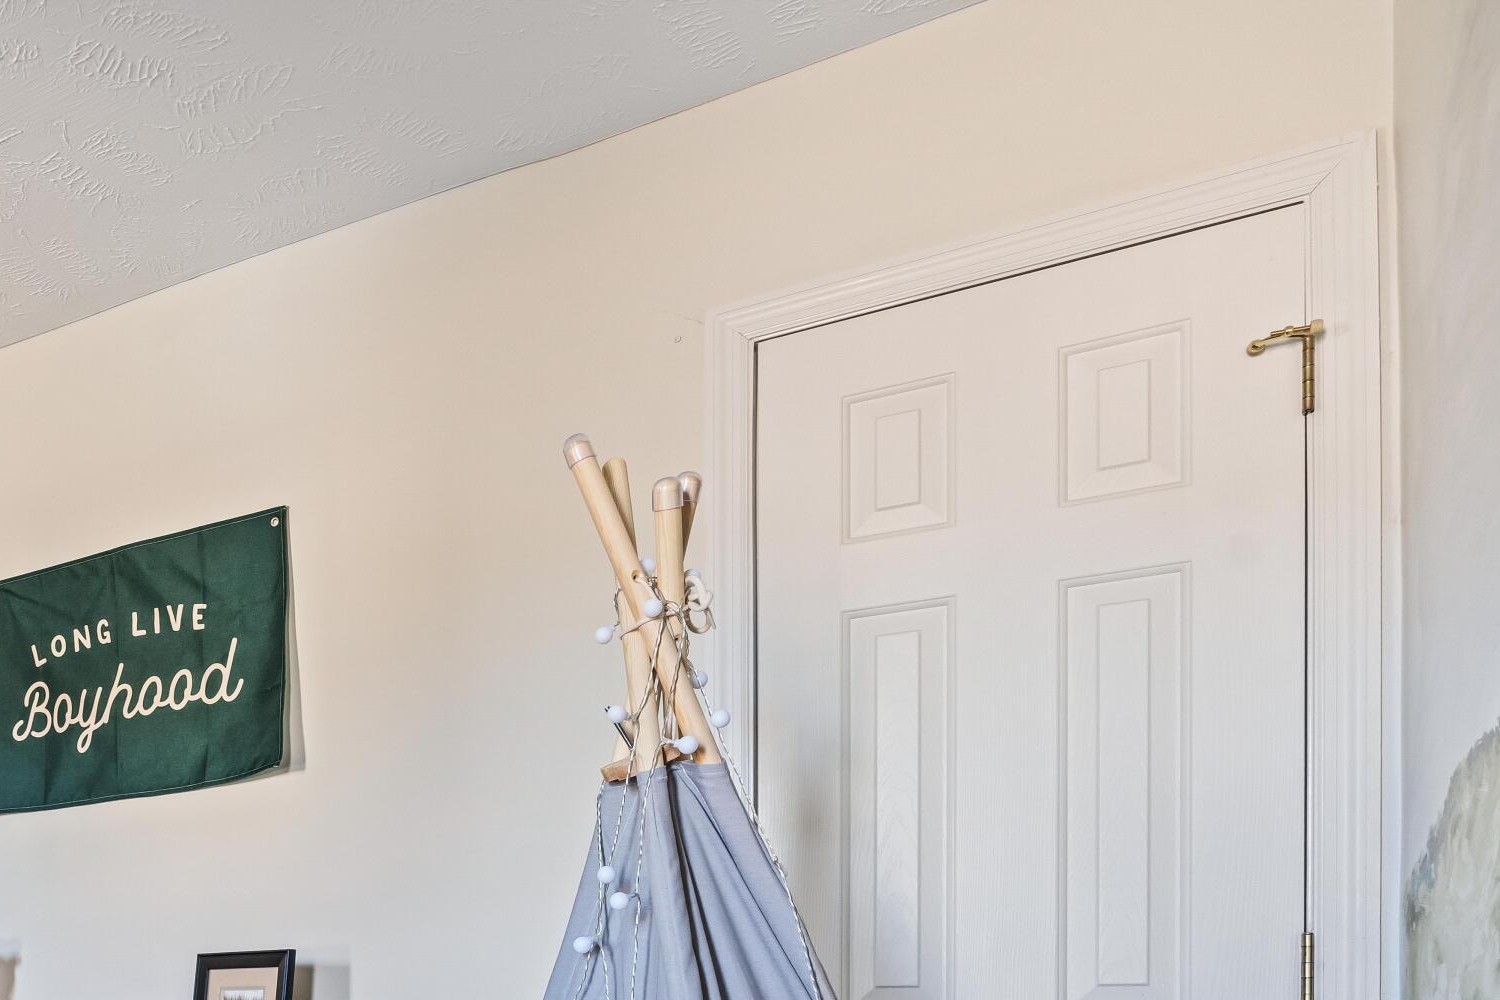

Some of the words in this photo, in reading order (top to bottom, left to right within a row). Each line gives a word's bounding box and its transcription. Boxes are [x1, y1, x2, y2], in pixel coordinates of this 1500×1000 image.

[30, 618, 112, 668] LONG
[131, 603, 208, 637] LIVE
[11, 637, 245, 754] Boyhood
